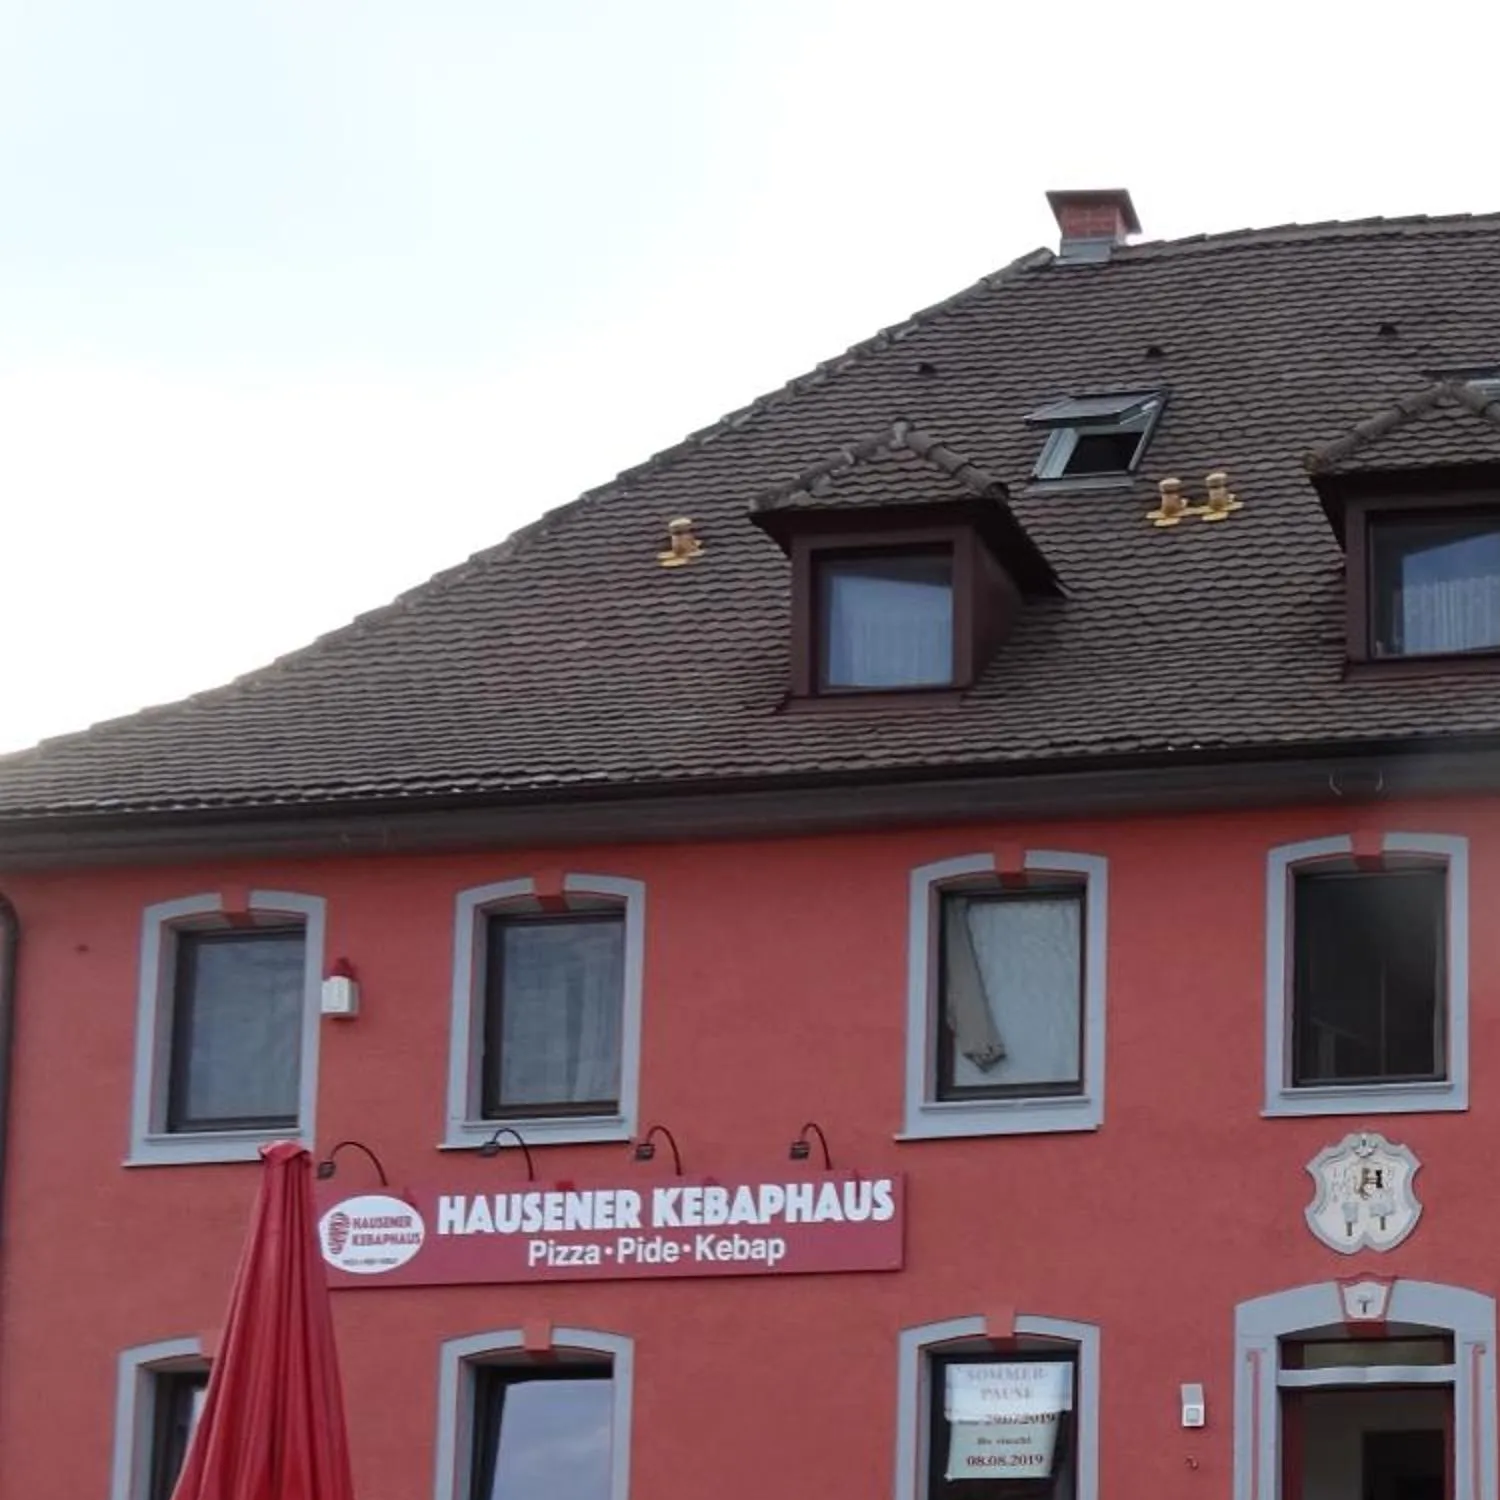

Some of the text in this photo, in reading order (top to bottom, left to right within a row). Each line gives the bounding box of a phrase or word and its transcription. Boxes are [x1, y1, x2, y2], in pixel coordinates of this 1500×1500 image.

[437, 1180, 895, 1235] HAUSENER KEBAPHAUS
[352, 1215, 412, 1230] HAUSENER
[528, 1233, 786, 1266] Pizza Pide Kebap
[966, 1453, 1044, 1467] 08.08.2019
